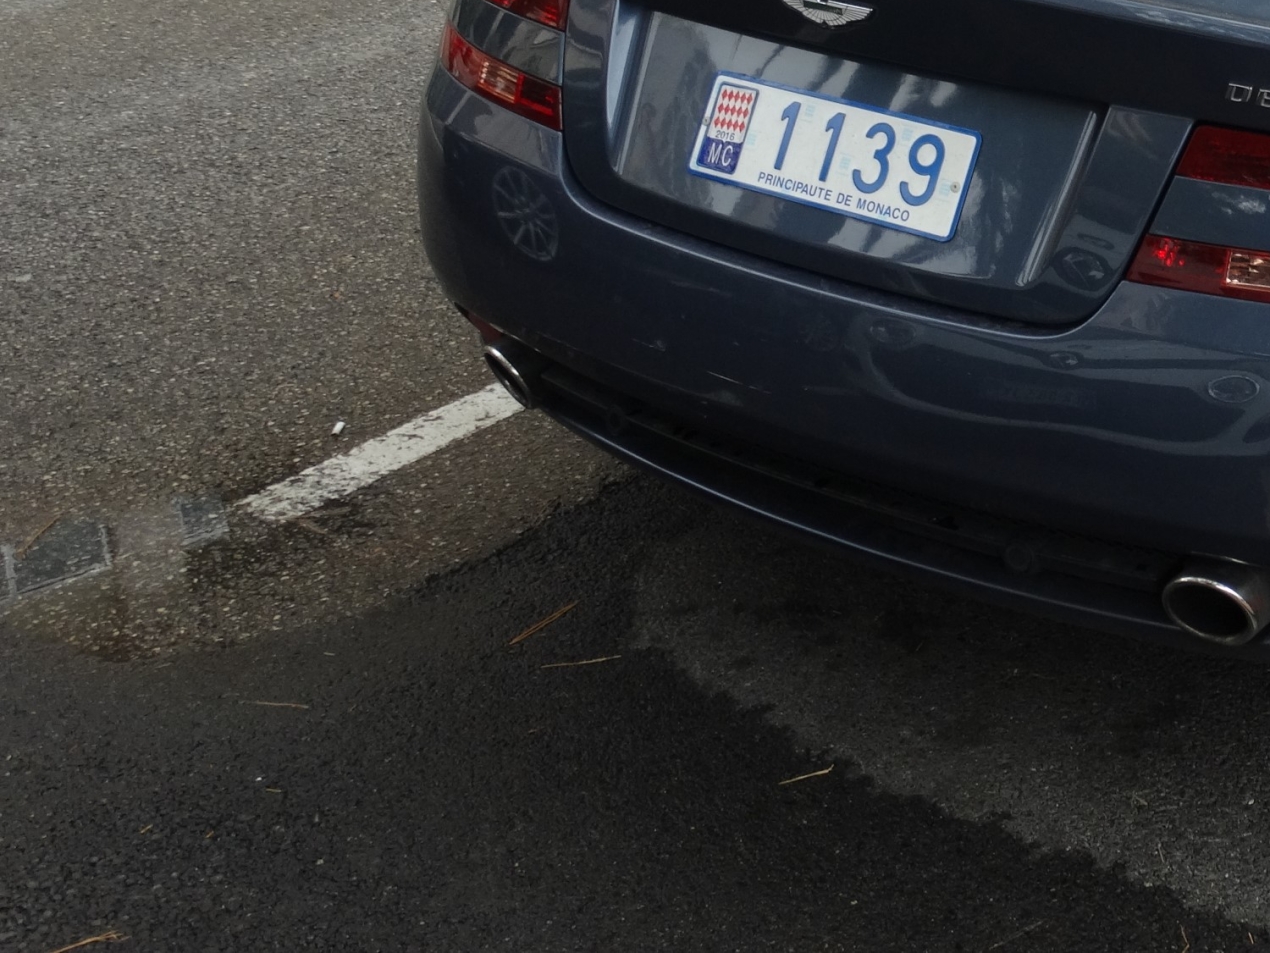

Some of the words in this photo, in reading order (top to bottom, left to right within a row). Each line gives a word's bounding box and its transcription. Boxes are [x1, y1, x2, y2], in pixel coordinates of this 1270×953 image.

[715, 129, 736, 141] 2016
[707, 142, 734, 167] MC
[773, 101, 946, 207] 1139
[758, 172, 833, 201] PRINCIPAUTE
[836, 193, 852, 206] DE
[856, 198, 910, 222] MONACO
